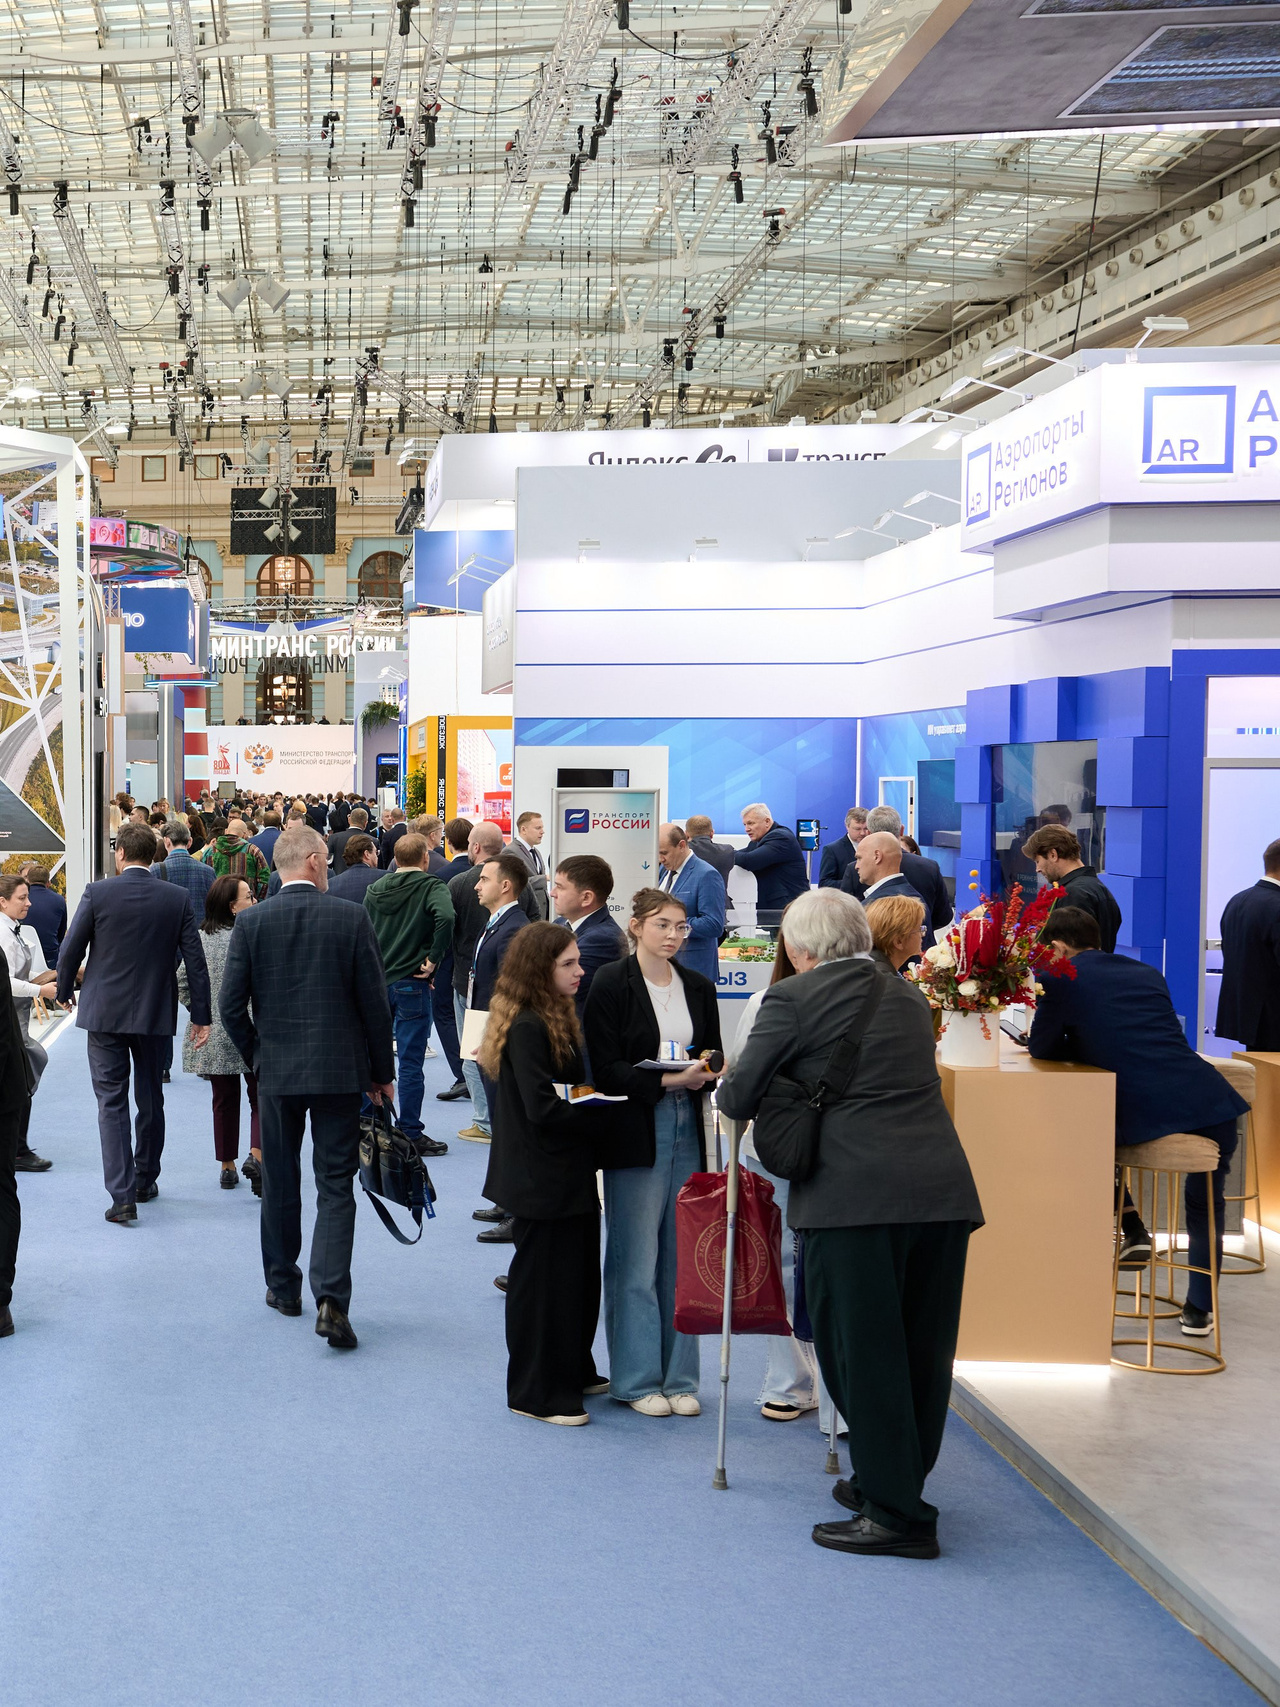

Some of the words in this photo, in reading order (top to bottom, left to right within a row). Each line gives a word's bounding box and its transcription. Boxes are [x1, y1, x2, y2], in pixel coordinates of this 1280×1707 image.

[994, 410, 1084, 471] Аэропорты
[1156, 438, 1200, 462] AR
[994, 461, 1068, 511] Регионов
[969, 492, 982, 514] AR
[211, 635, 318, 659] МИНТРАНС
[438, 715, 446, 750] ПОЕЗДОК
[318, 758, 351, 766] ФЕДЕРАЦИИ
[592, 819, 651, 829] РОССИИ
[716, 971, 748, 986] ЫЗ
